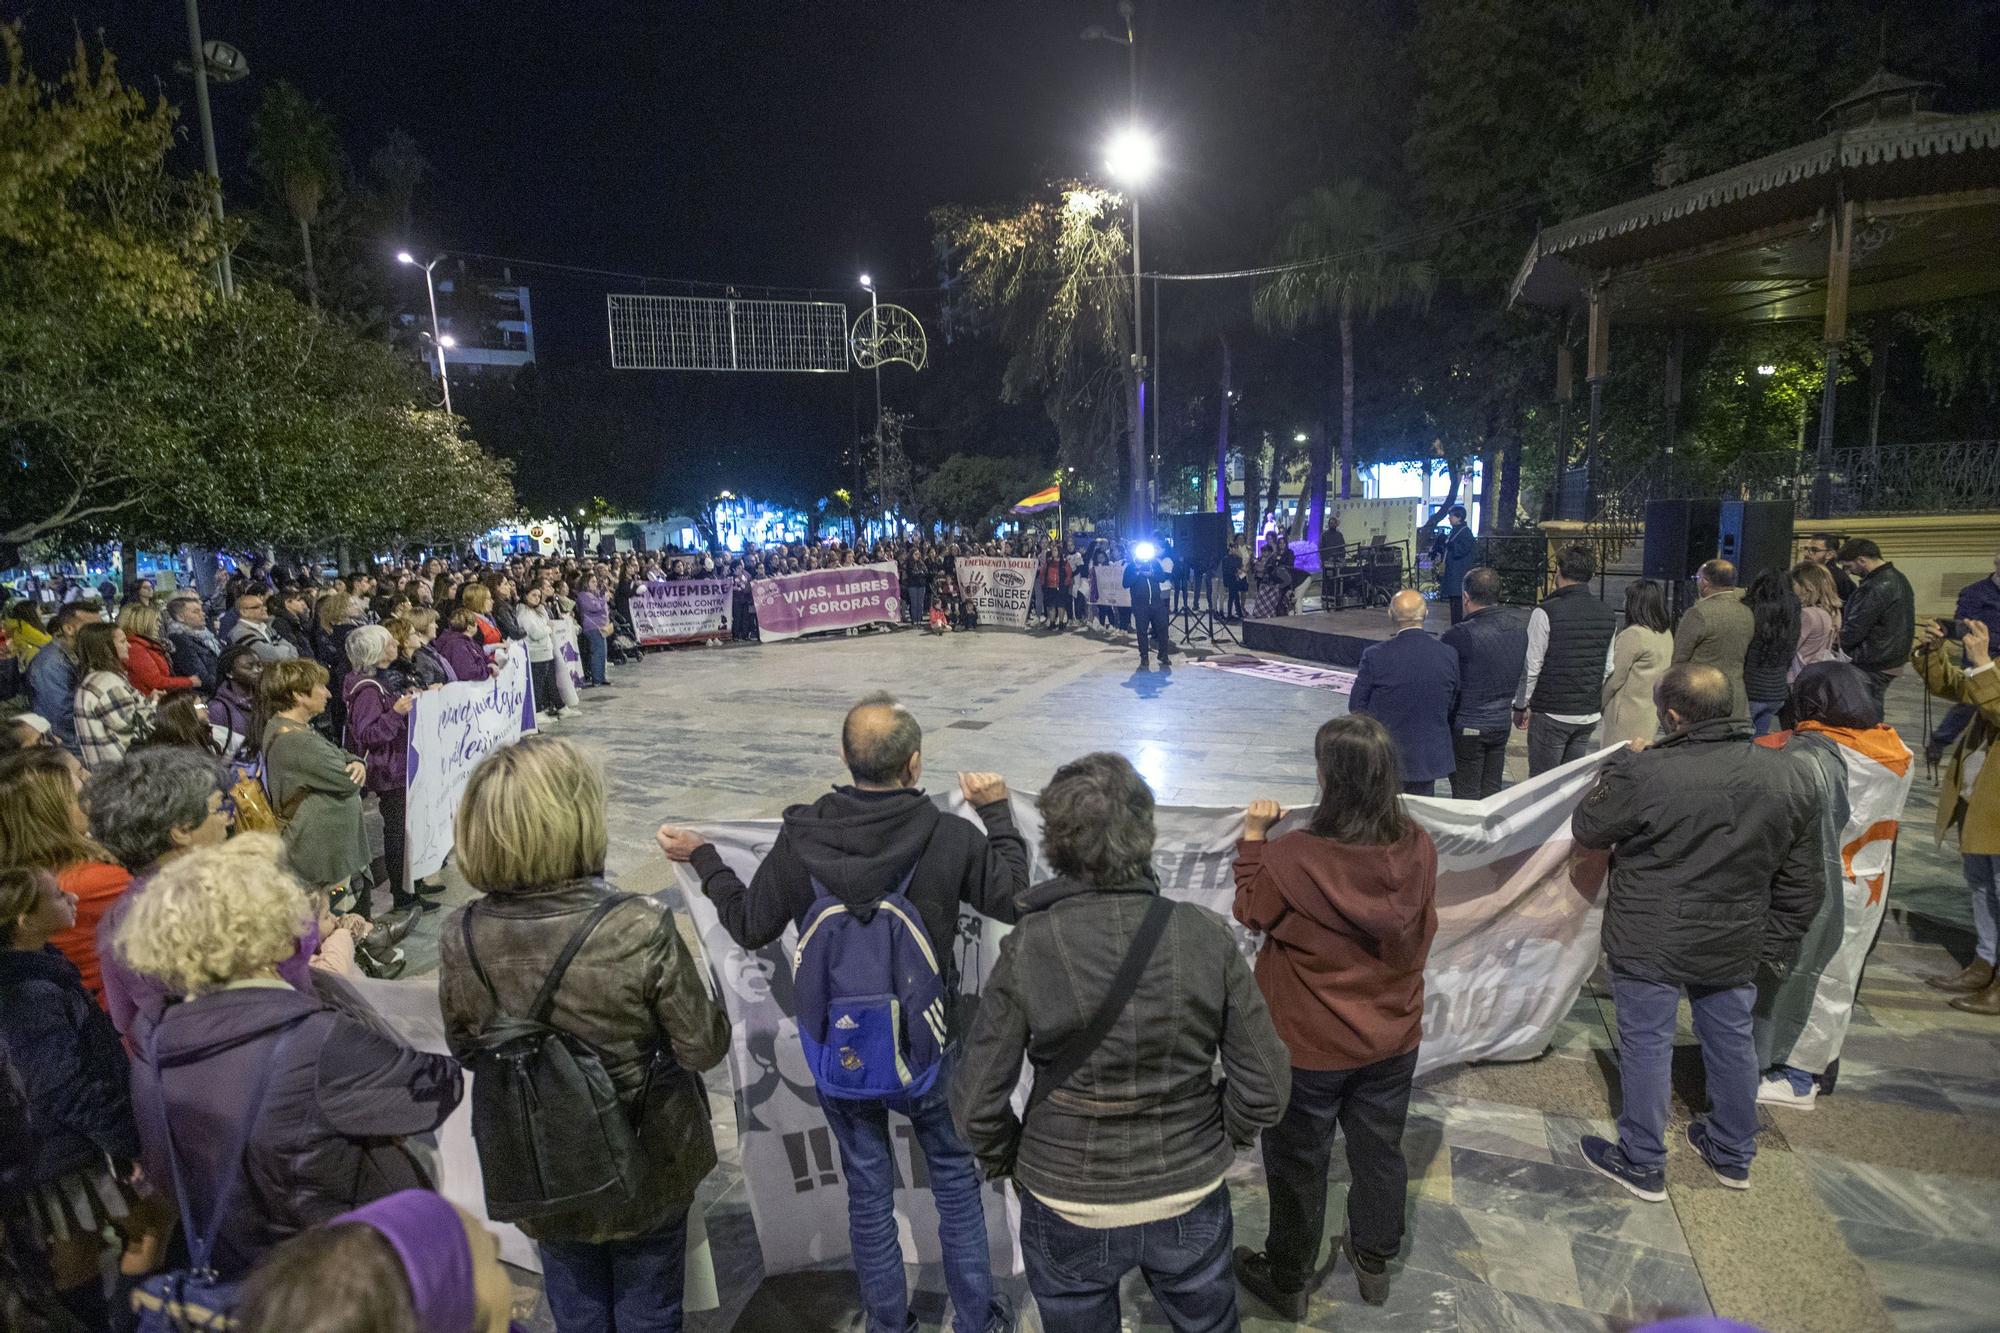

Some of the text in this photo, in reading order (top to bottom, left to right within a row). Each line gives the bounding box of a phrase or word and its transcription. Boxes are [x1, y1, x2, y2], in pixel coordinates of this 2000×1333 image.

[1008, 561, 1031, 569] SOCIAL
[783, 585, 832, 604] VIVAS,
[836, 578, 889, 596] LIBRES
[796, 595, 880, 618] Y SORORAS
[973, 597, 1027, 610] SESINADA
[680, 606, 724, 617] MACHISTA
